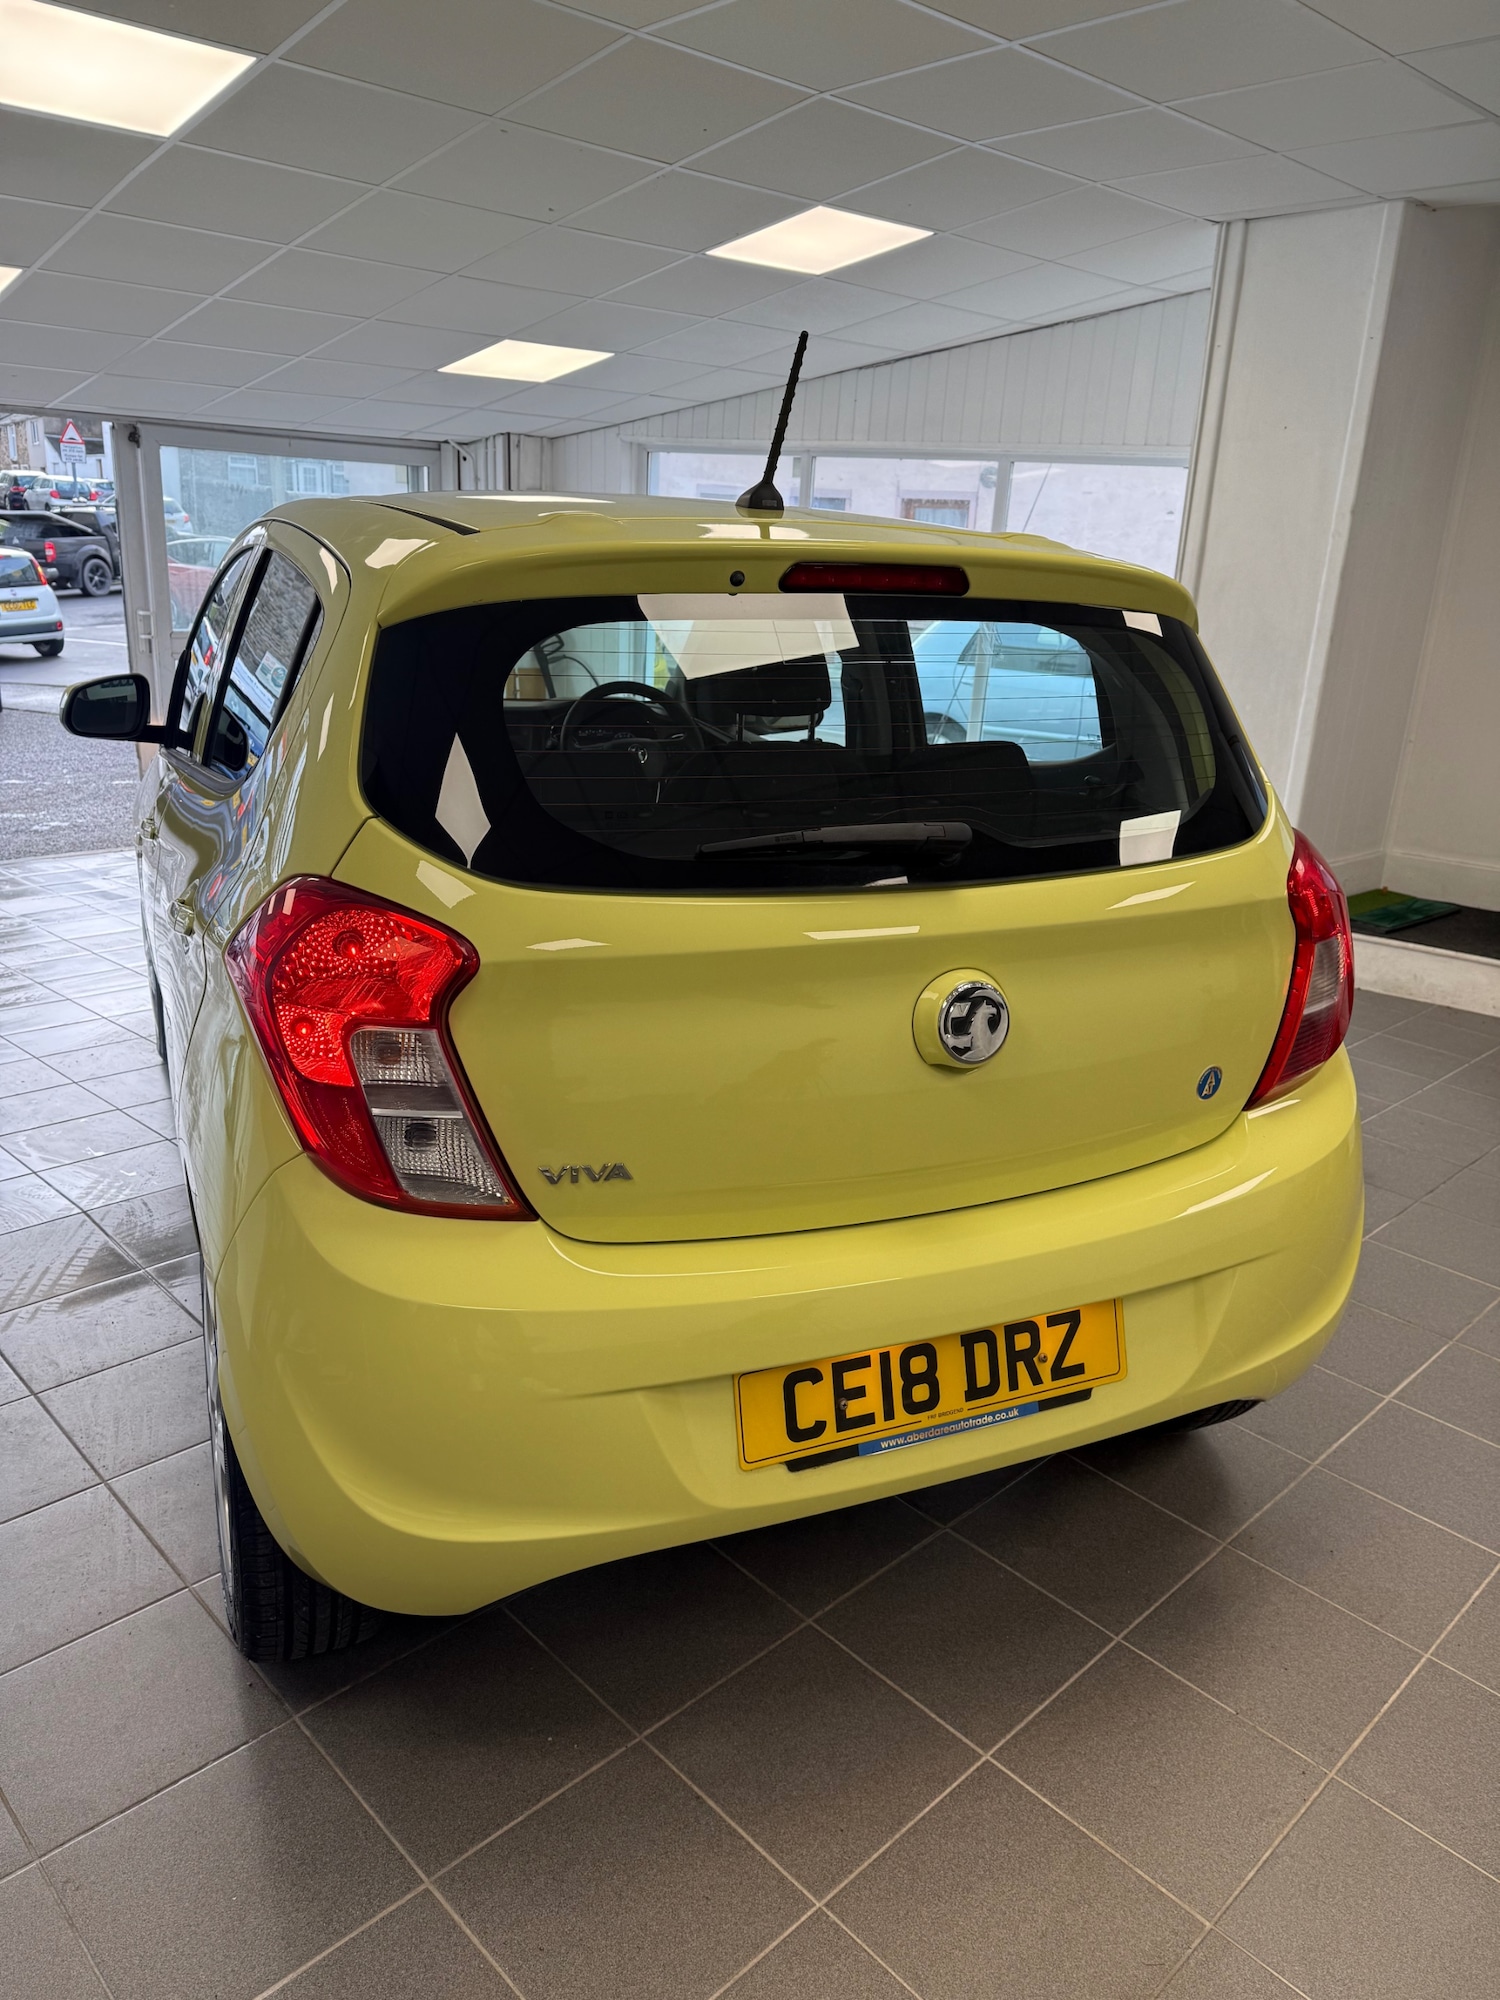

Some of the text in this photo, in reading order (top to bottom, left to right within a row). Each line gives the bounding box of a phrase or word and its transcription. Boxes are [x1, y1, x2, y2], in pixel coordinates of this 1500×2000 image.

[538, 1162, 634, 1185] VIVA
[782, 1309, 1086, 1443] CE18 DRZ
[880, 1407, 1020, 1449] www.aberdareautotrade.co.uk
[938, 1407, 964, 1418] BRIDGEND
